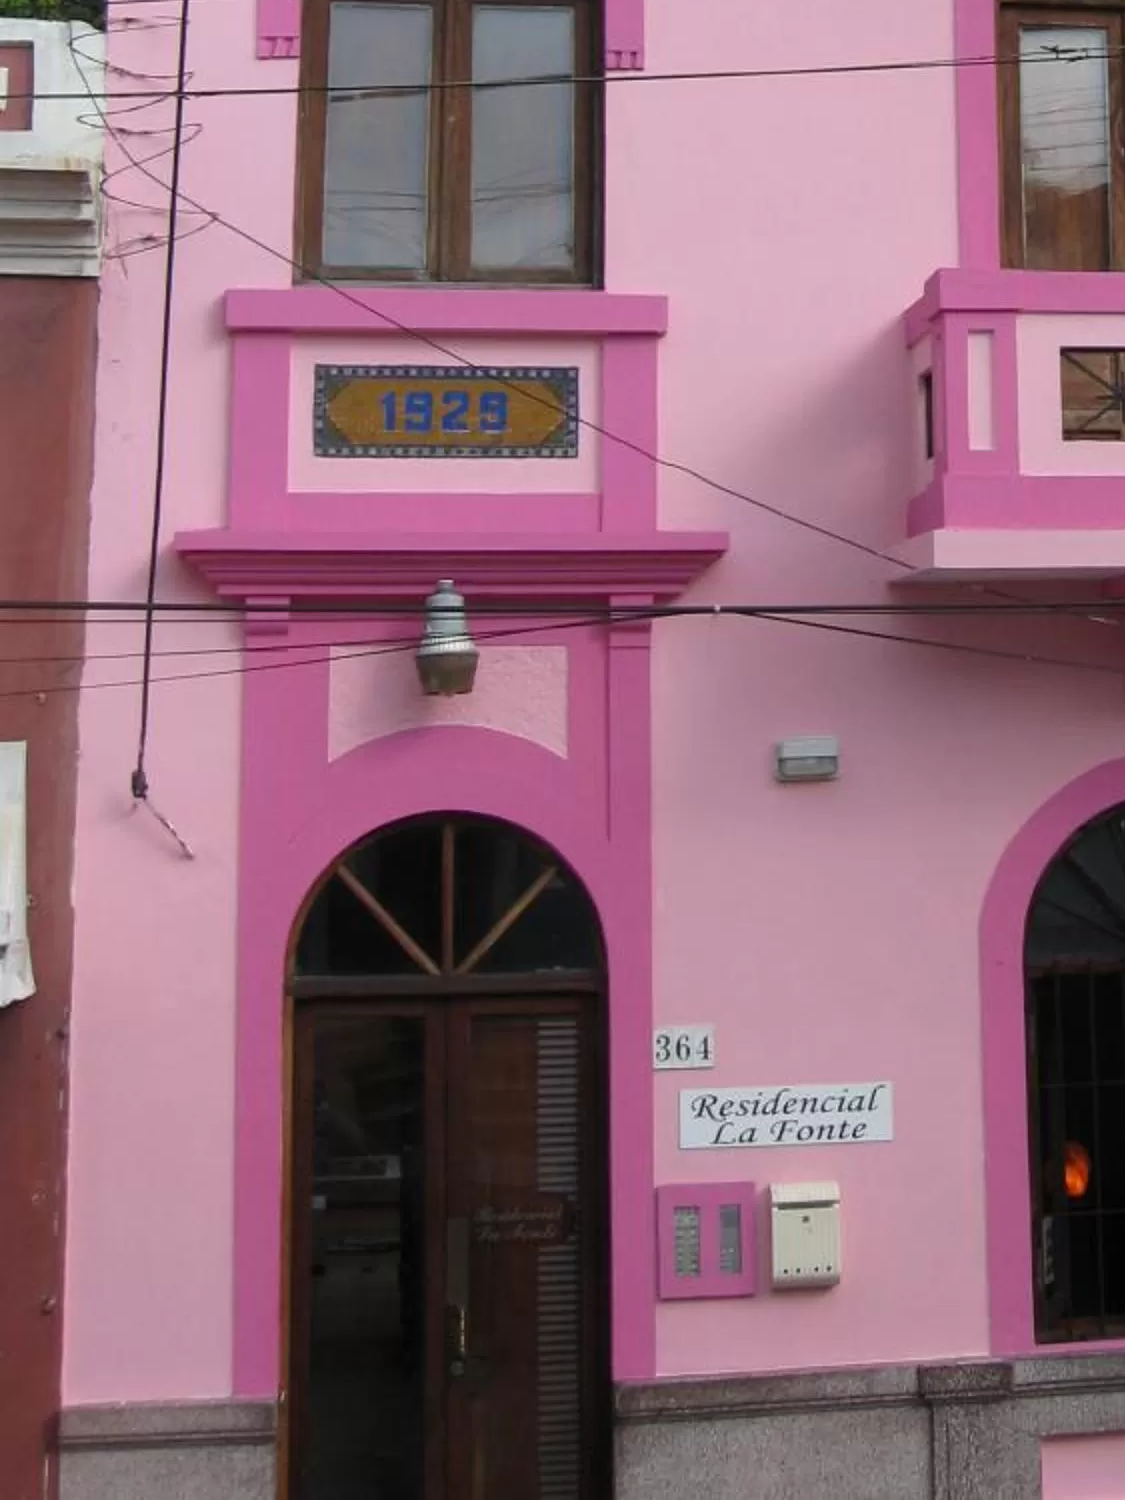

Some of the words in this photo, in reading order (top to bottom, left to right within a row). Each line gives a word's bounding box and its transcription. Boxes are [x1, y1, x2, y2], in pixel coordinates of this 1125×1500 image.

[379, 390, 509, 435] 1929
[655, 1034, 712, 1061] 364
[691, 1084, 886, 1123] Residencial
[710, 1122, 758, 1145] La
[770, 1119, 867, 1143] Fonte
